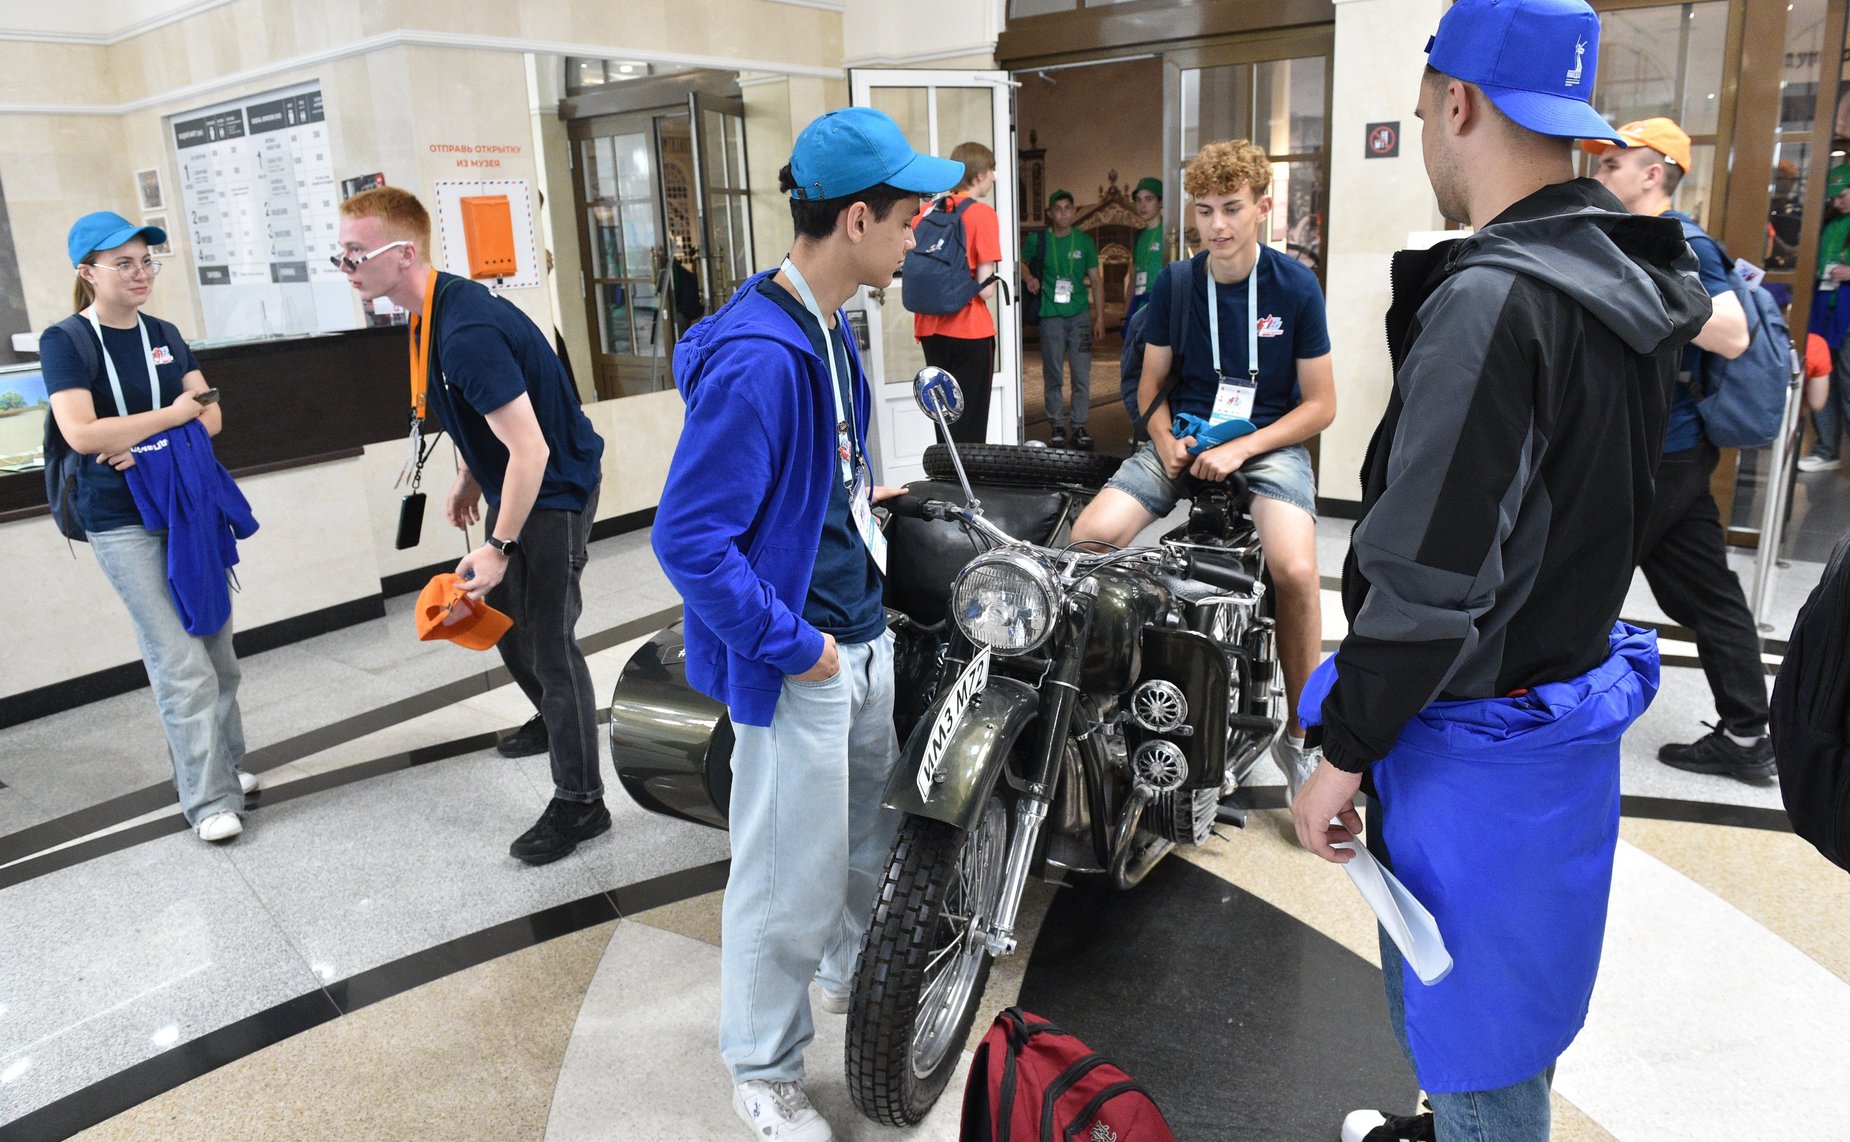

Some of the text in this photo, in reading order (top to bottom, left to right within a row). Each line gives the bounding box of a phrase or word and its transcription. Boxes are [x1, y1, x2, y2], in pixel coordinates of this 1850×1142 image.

[429, 144, 521, 154] ОТПРАВЬ ОТКРЫТКУ
[456, 159, 501, 168] ИЗ МУЗЕЯ
[923, 707, 954, 783] ИМЗ
